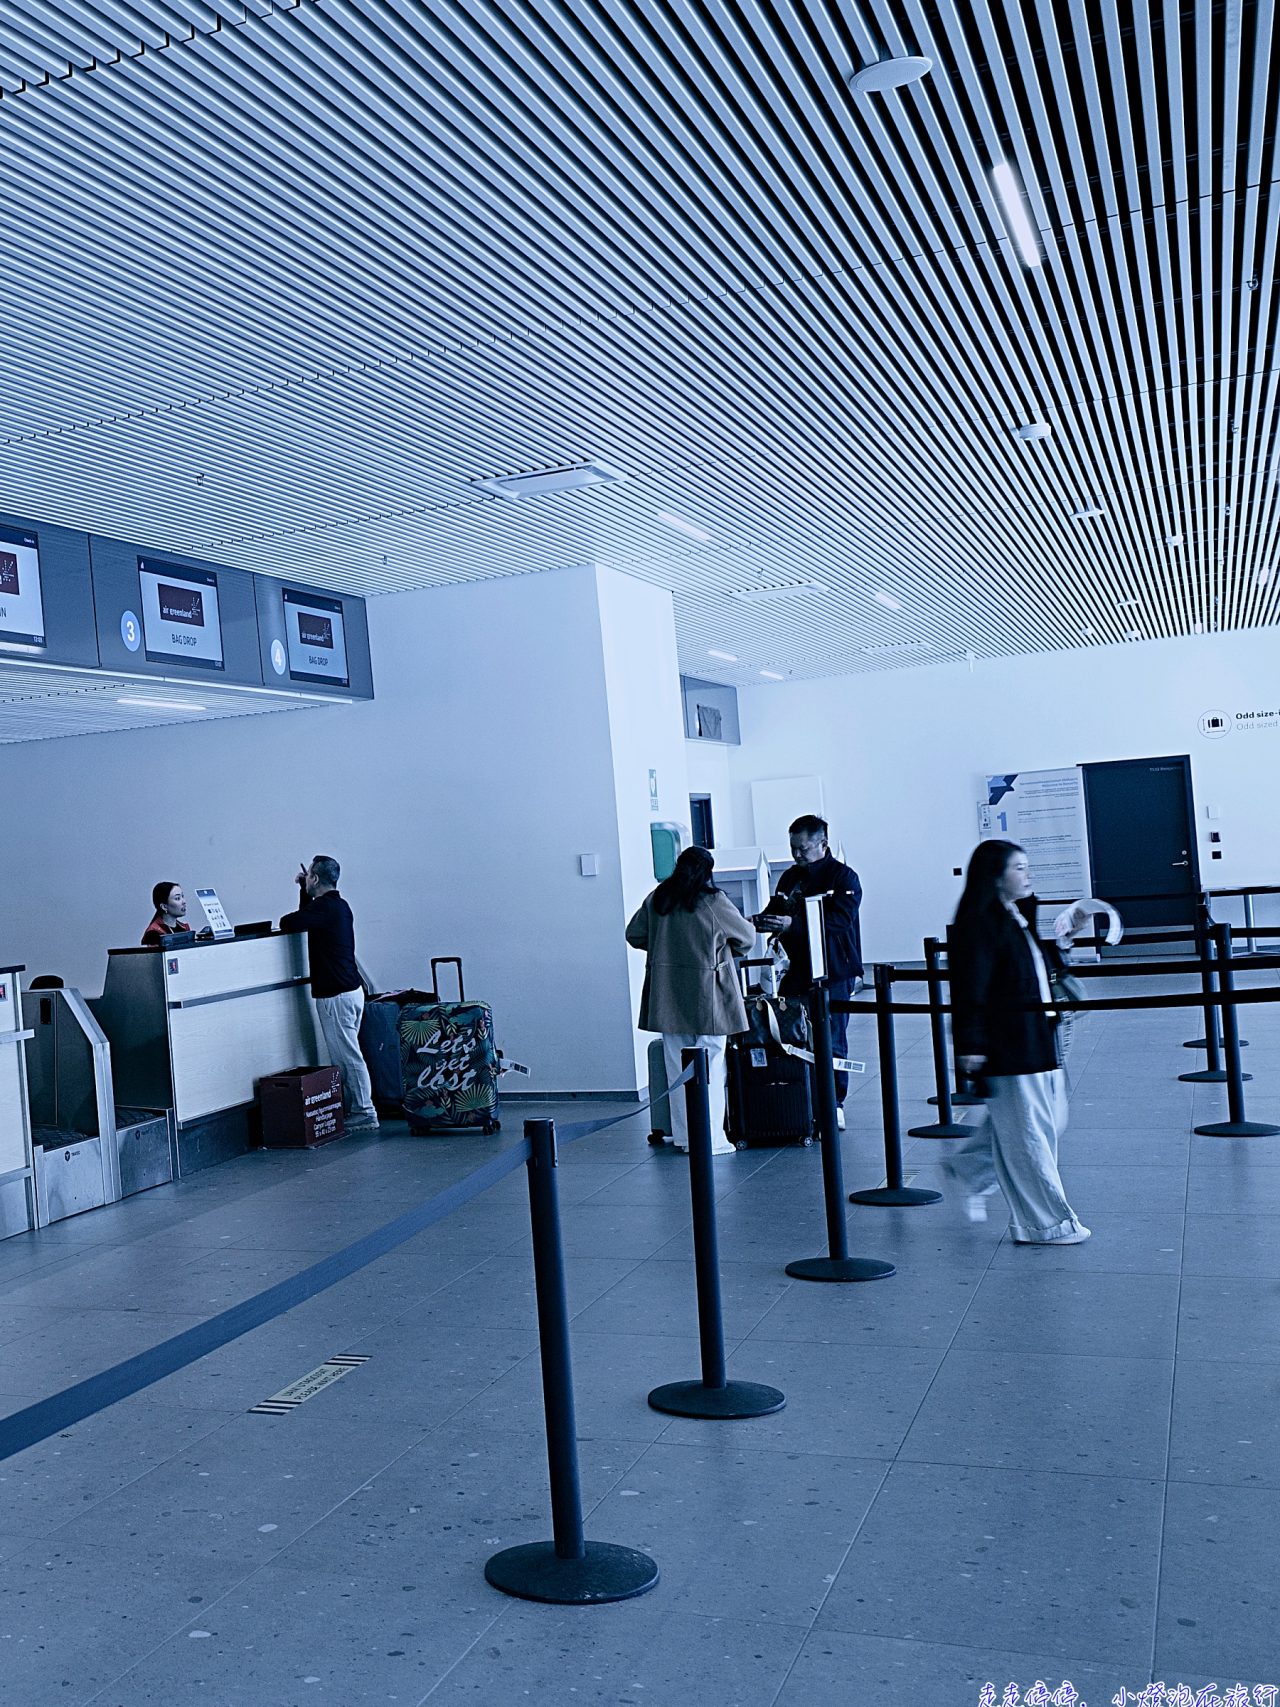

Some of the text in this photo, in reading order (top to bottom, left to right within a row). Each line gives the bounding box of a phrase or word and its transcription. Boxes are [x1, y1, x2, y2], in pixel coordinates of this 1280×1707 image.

[126, 619, 135, 642] 3
[171, 633, 197, 647] BAG DROP
[274, 647, 282, 666] 4
[1236, 711, 1255, 720] Odd
[1237, 720, 1278, 731] Odd sized
[997, 811, 1007, 832] 1
[416, 1028, 476, 1054] Let's
[436, 1054, 471, 1077] get
[417, 1065, 477, 1091] lost
